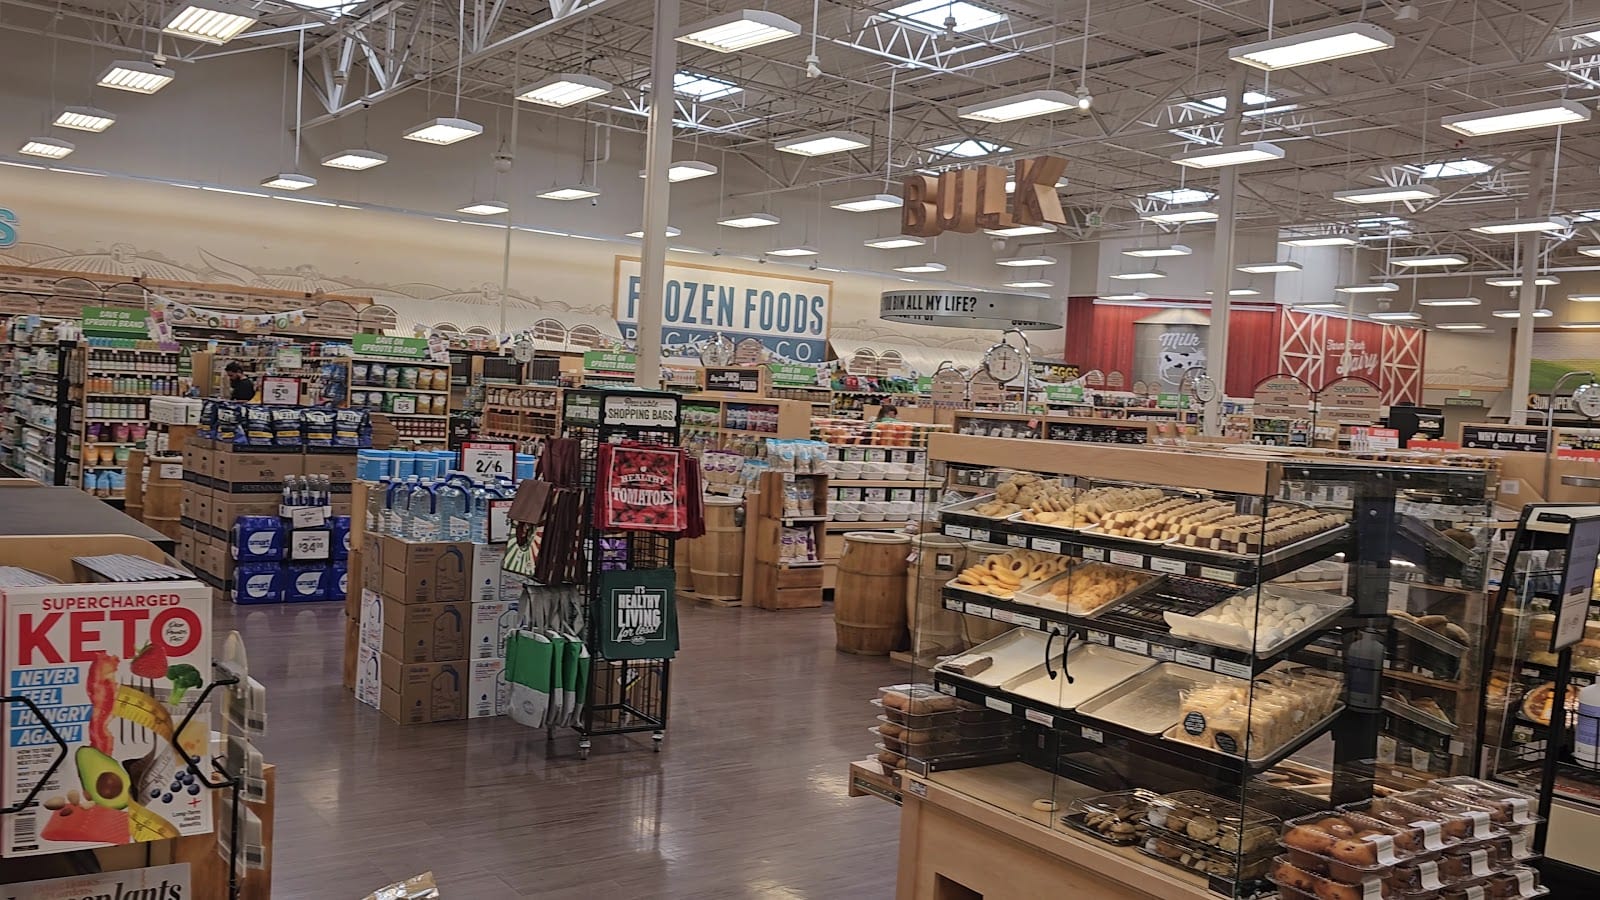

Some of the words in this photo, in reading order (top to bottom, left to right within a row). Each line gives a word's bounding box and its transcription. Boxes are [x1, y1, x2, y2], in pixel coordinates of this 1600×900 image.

[901, 156, 1070, 237] BULK
[627, 276, 735, 327] FOZEN
[744, 288, 824, 335] FOODS
[906, 295, 923, 310] ALL
[926, 295, 942, 311] MY
[945, 295, 977, 312] LIFE?
[1159, 333, 1200, 349] Milk
[1336, 350, 1379, 375] Dairy
[1052, 366, 1079, 378] EGGS
[608, 408, 650, 420] SHOPPING
[652, 409, 674, 421] BAGS
[1497, 432, 1514, 443] BUY
[1515, 433, 1537, 444] BULK
[619, 473, 668, 485] HEALTHY
[611, 487, 674, 506] TOMATOES
[42, 594, 181, 610] SUPERCHARGED
[618, 594, 661, 609] HEALTHY
[617, 608, 662, 628] LIVING
[18, 606, 203, 666] KETO
[616, 623, 634, 643] for
[18, 670, 77, 687] NEVER
[19, 688, 58, 706] FEEL
[18, 706, 91, 726] HUNGRY
[17, 725, 80, 745] AGAN!
